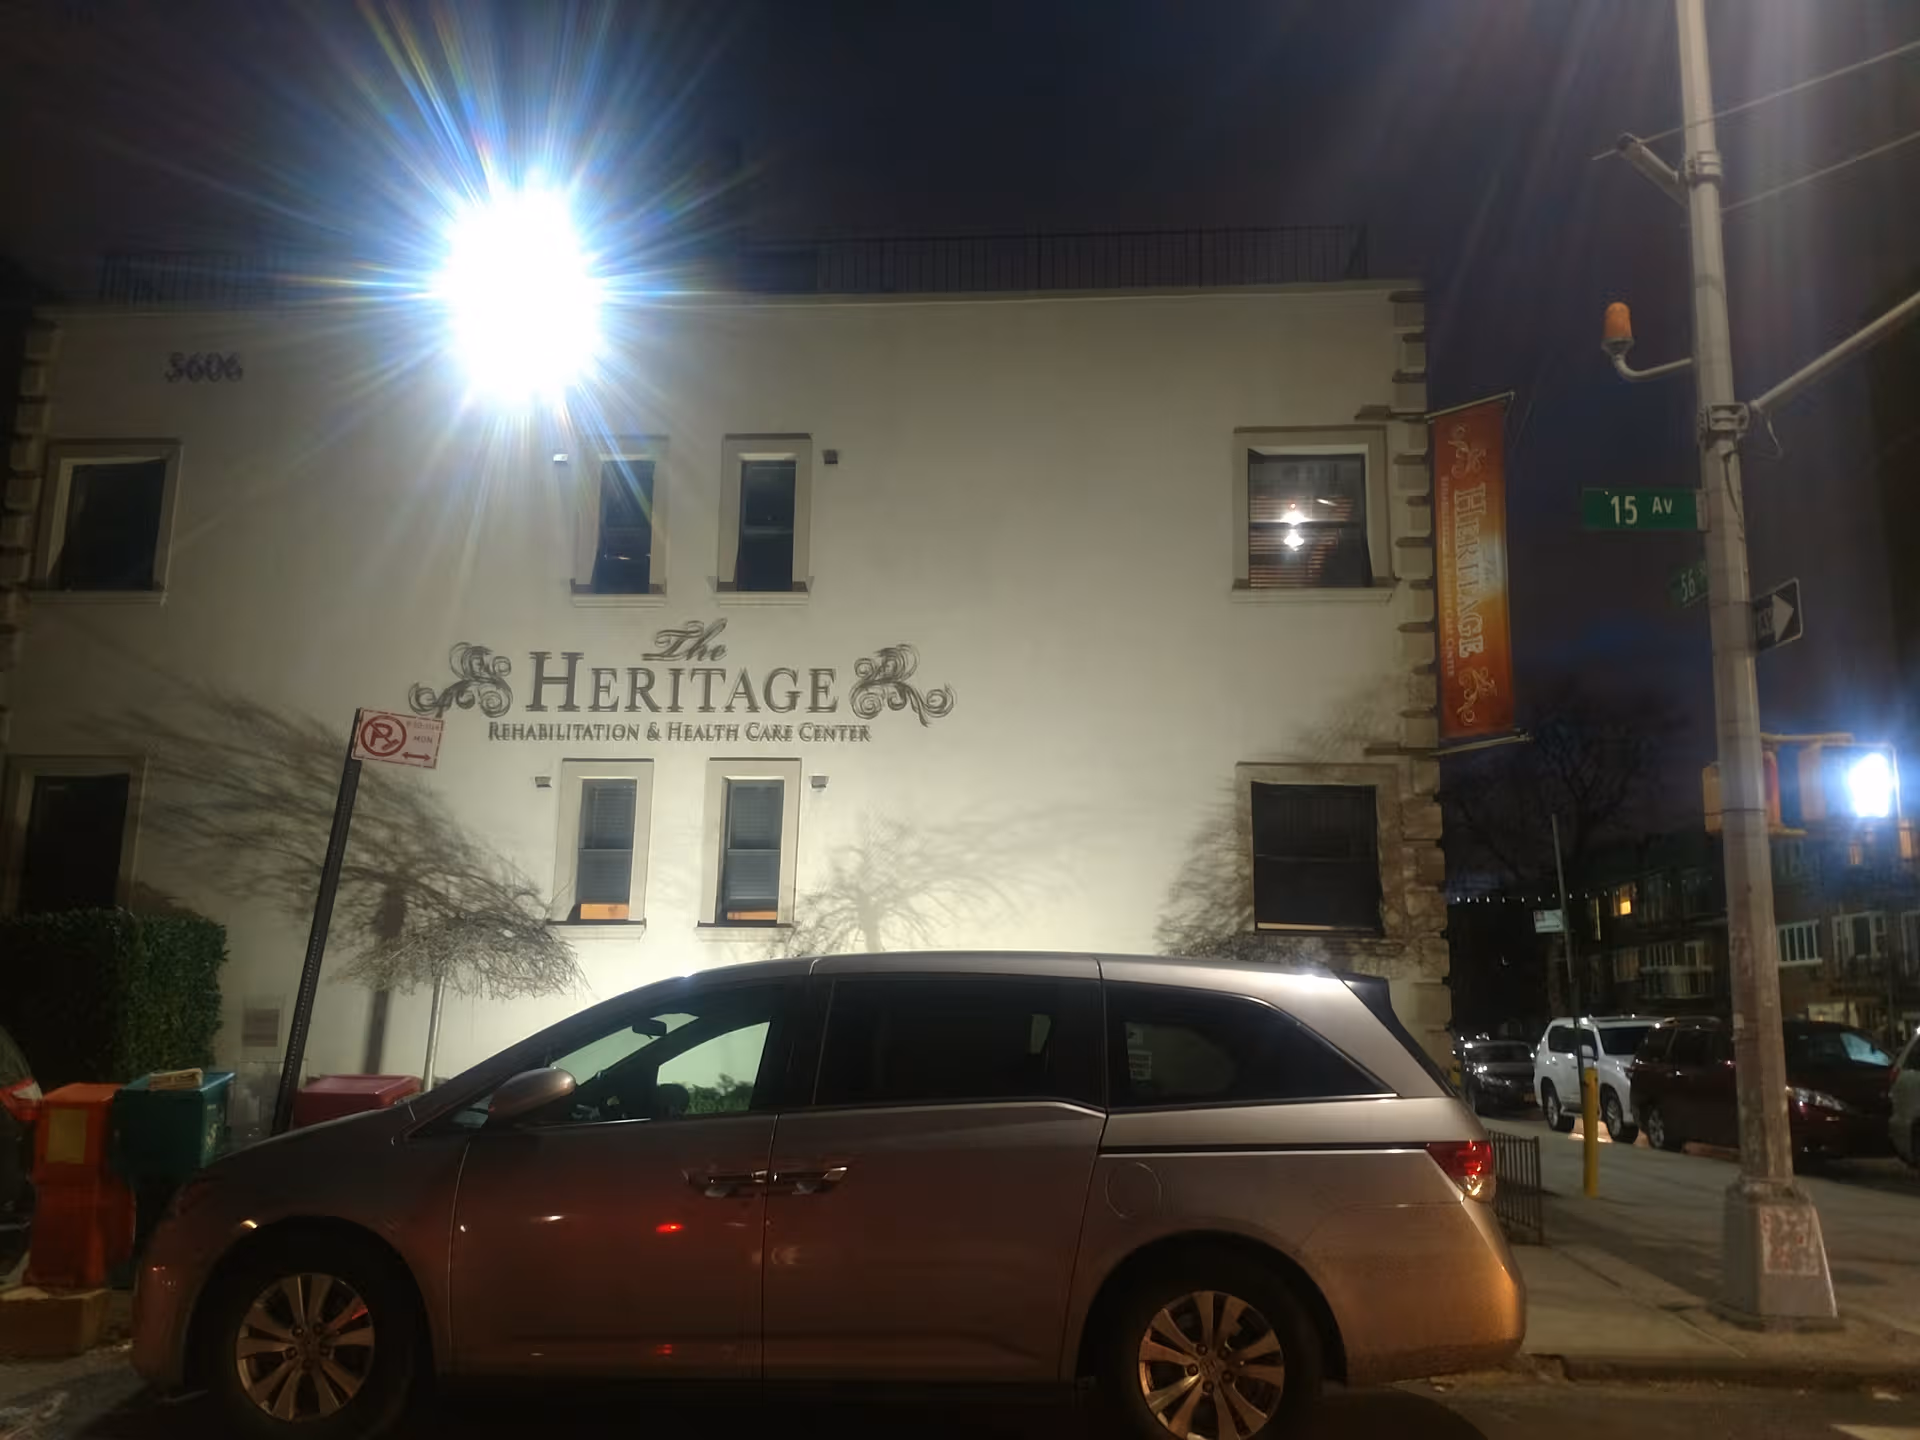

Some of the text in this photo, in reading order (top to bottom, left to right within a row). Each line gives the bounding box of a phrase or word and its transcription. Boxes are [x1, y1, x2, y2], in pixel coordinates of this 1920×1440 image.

[1610, 495, 1638, 525] 15
[1453, 482, 1488, 658] HERITAGE
[1680, 568, 1696, 602] 56
[641, 618, 728, 661] The
[525, 651, 839, 713] HERITAGE
[488, 722, 872, 742] REHABILITATION & HEALTH CARE CENTER
